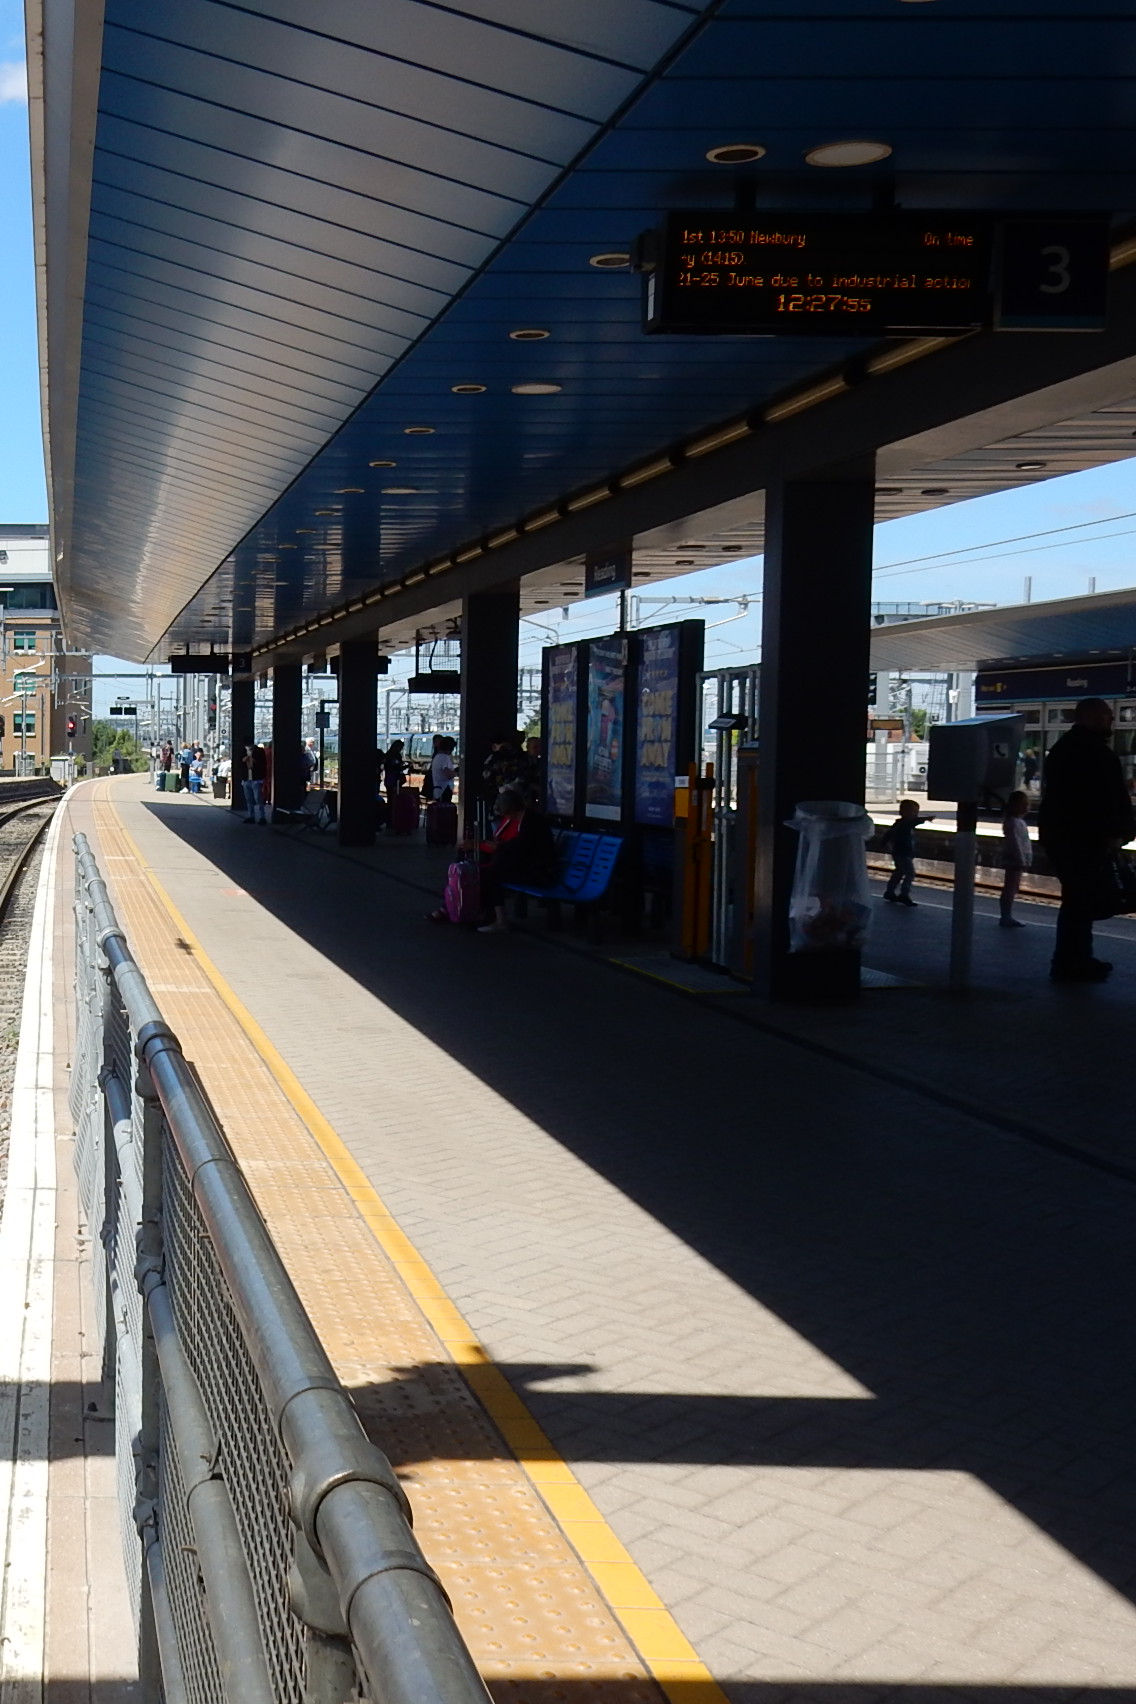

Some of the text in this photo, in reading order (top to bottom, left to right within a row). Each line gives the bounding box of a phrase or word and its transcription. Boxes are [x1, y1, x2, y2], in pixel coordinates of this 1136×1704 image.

[683, 229, 807, 248] 1st 13:50 Newbury
[924, 232, 974, 246] On time
[1040, 245, 1071, 294] 3
[728, 272, 764, 287] June
[771, 273, 799, 287] due
[807, 273, 823, 287] to
[832, 274, 916, 288] industrial
[777, 293, 872, 312] 12:27:55
[594, 561, 616, 582] Reading
